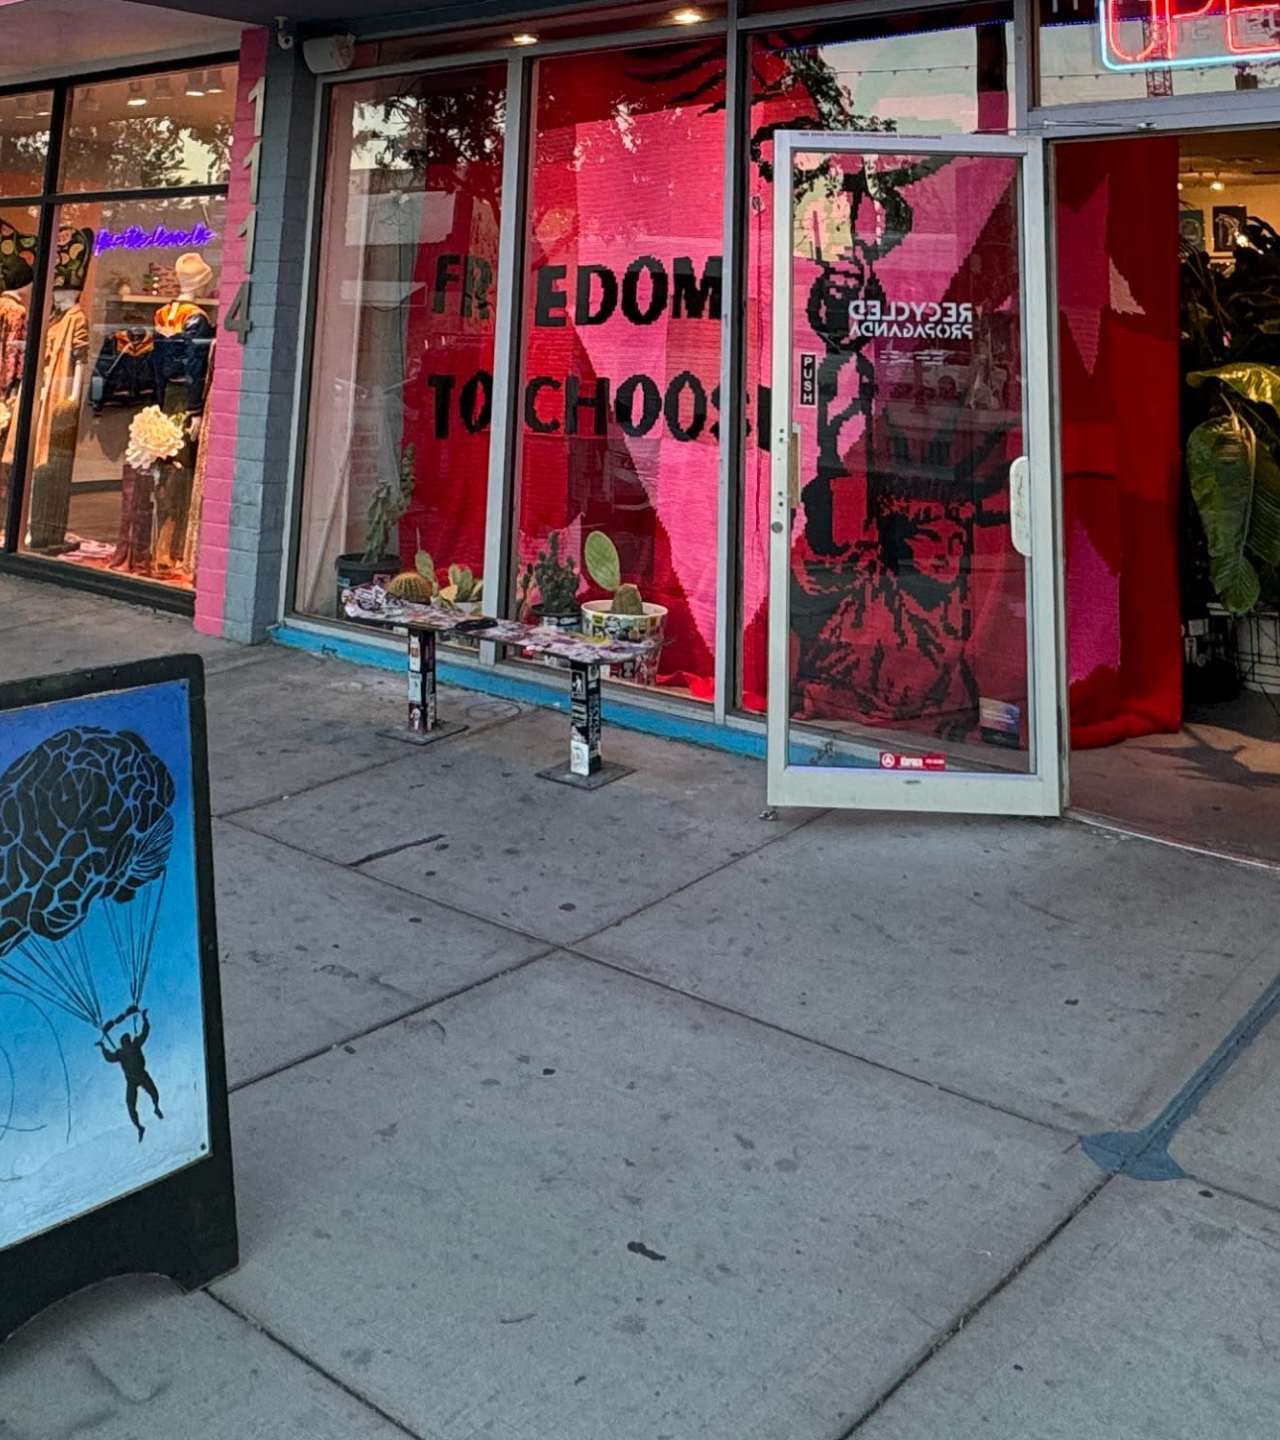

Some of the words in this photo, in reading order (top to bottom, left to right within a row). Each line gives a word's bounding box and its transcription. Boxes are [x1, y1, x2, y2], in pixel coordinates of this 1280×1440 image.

[431, 254, 723, 328] FREDOM
[427, 369, 494, 441] TO
[524, 370, 772, 452] CHOOS
[802, 356, 813, 404] PUSH
